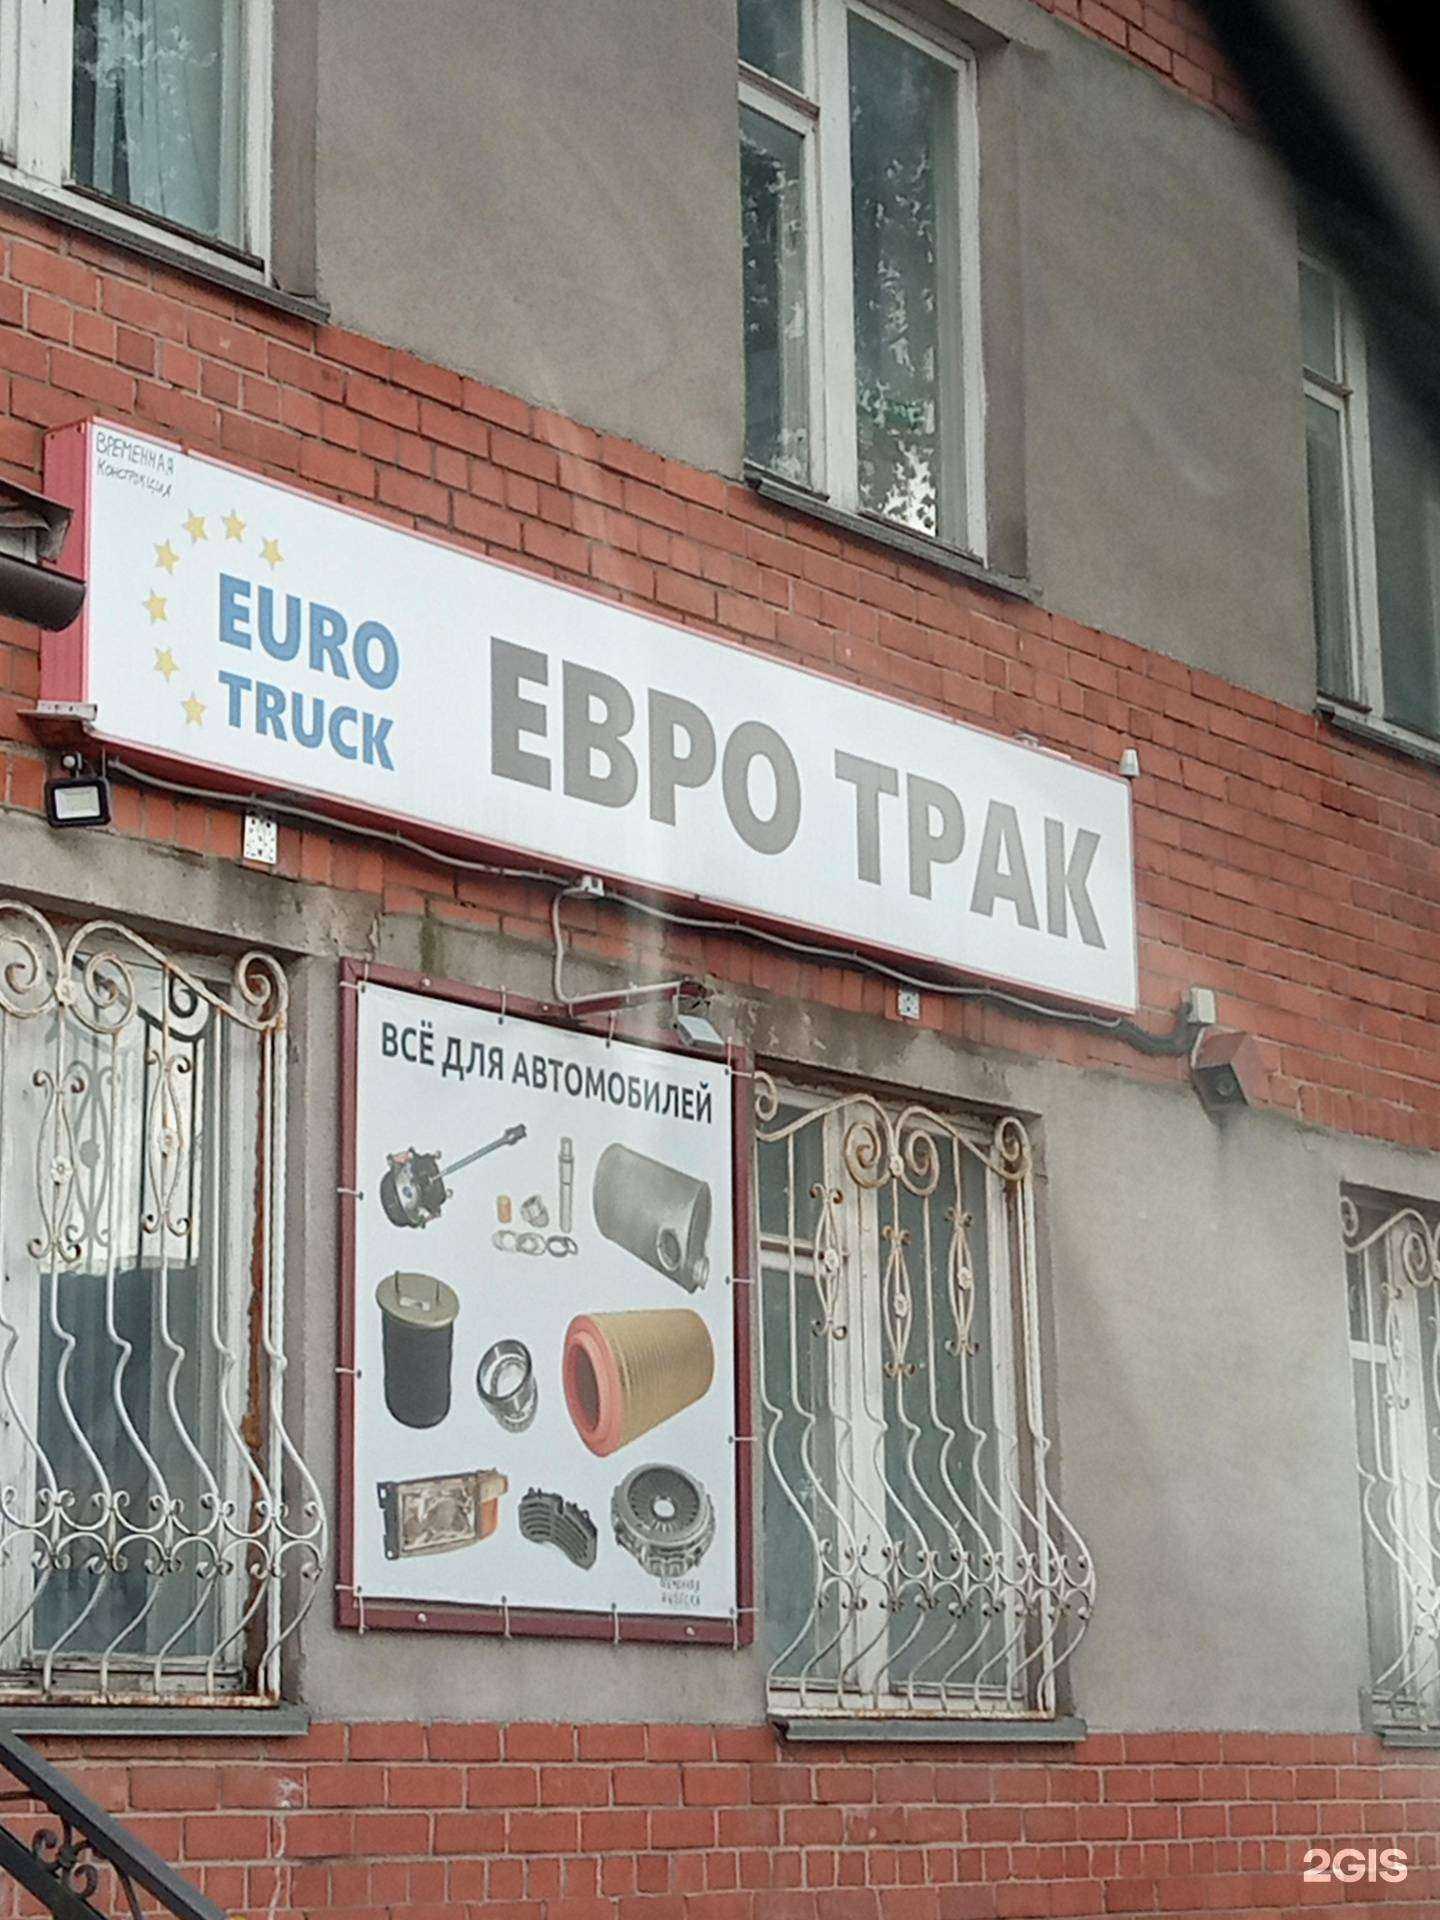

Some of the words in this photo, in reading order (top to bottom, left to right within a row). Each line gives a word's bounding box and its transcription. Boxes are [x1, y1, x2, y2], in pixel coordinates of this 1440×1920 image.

[96, 432, 174, 475] ВРЕМЕННАЯ
[218, 572, 400, 691] EURO
[217, 669, 395, 771] TRUCK
[490, 636, 801, 856] ЕВРО
[834, 748, 1107, 950] ТРАК
[381, 1020, 435, 1066] ВСЁ
[441, 1036, 504, 1082] ДЛЯ
[512, 1051, 713, 1124] АВТОМОБИЛЕЙ
